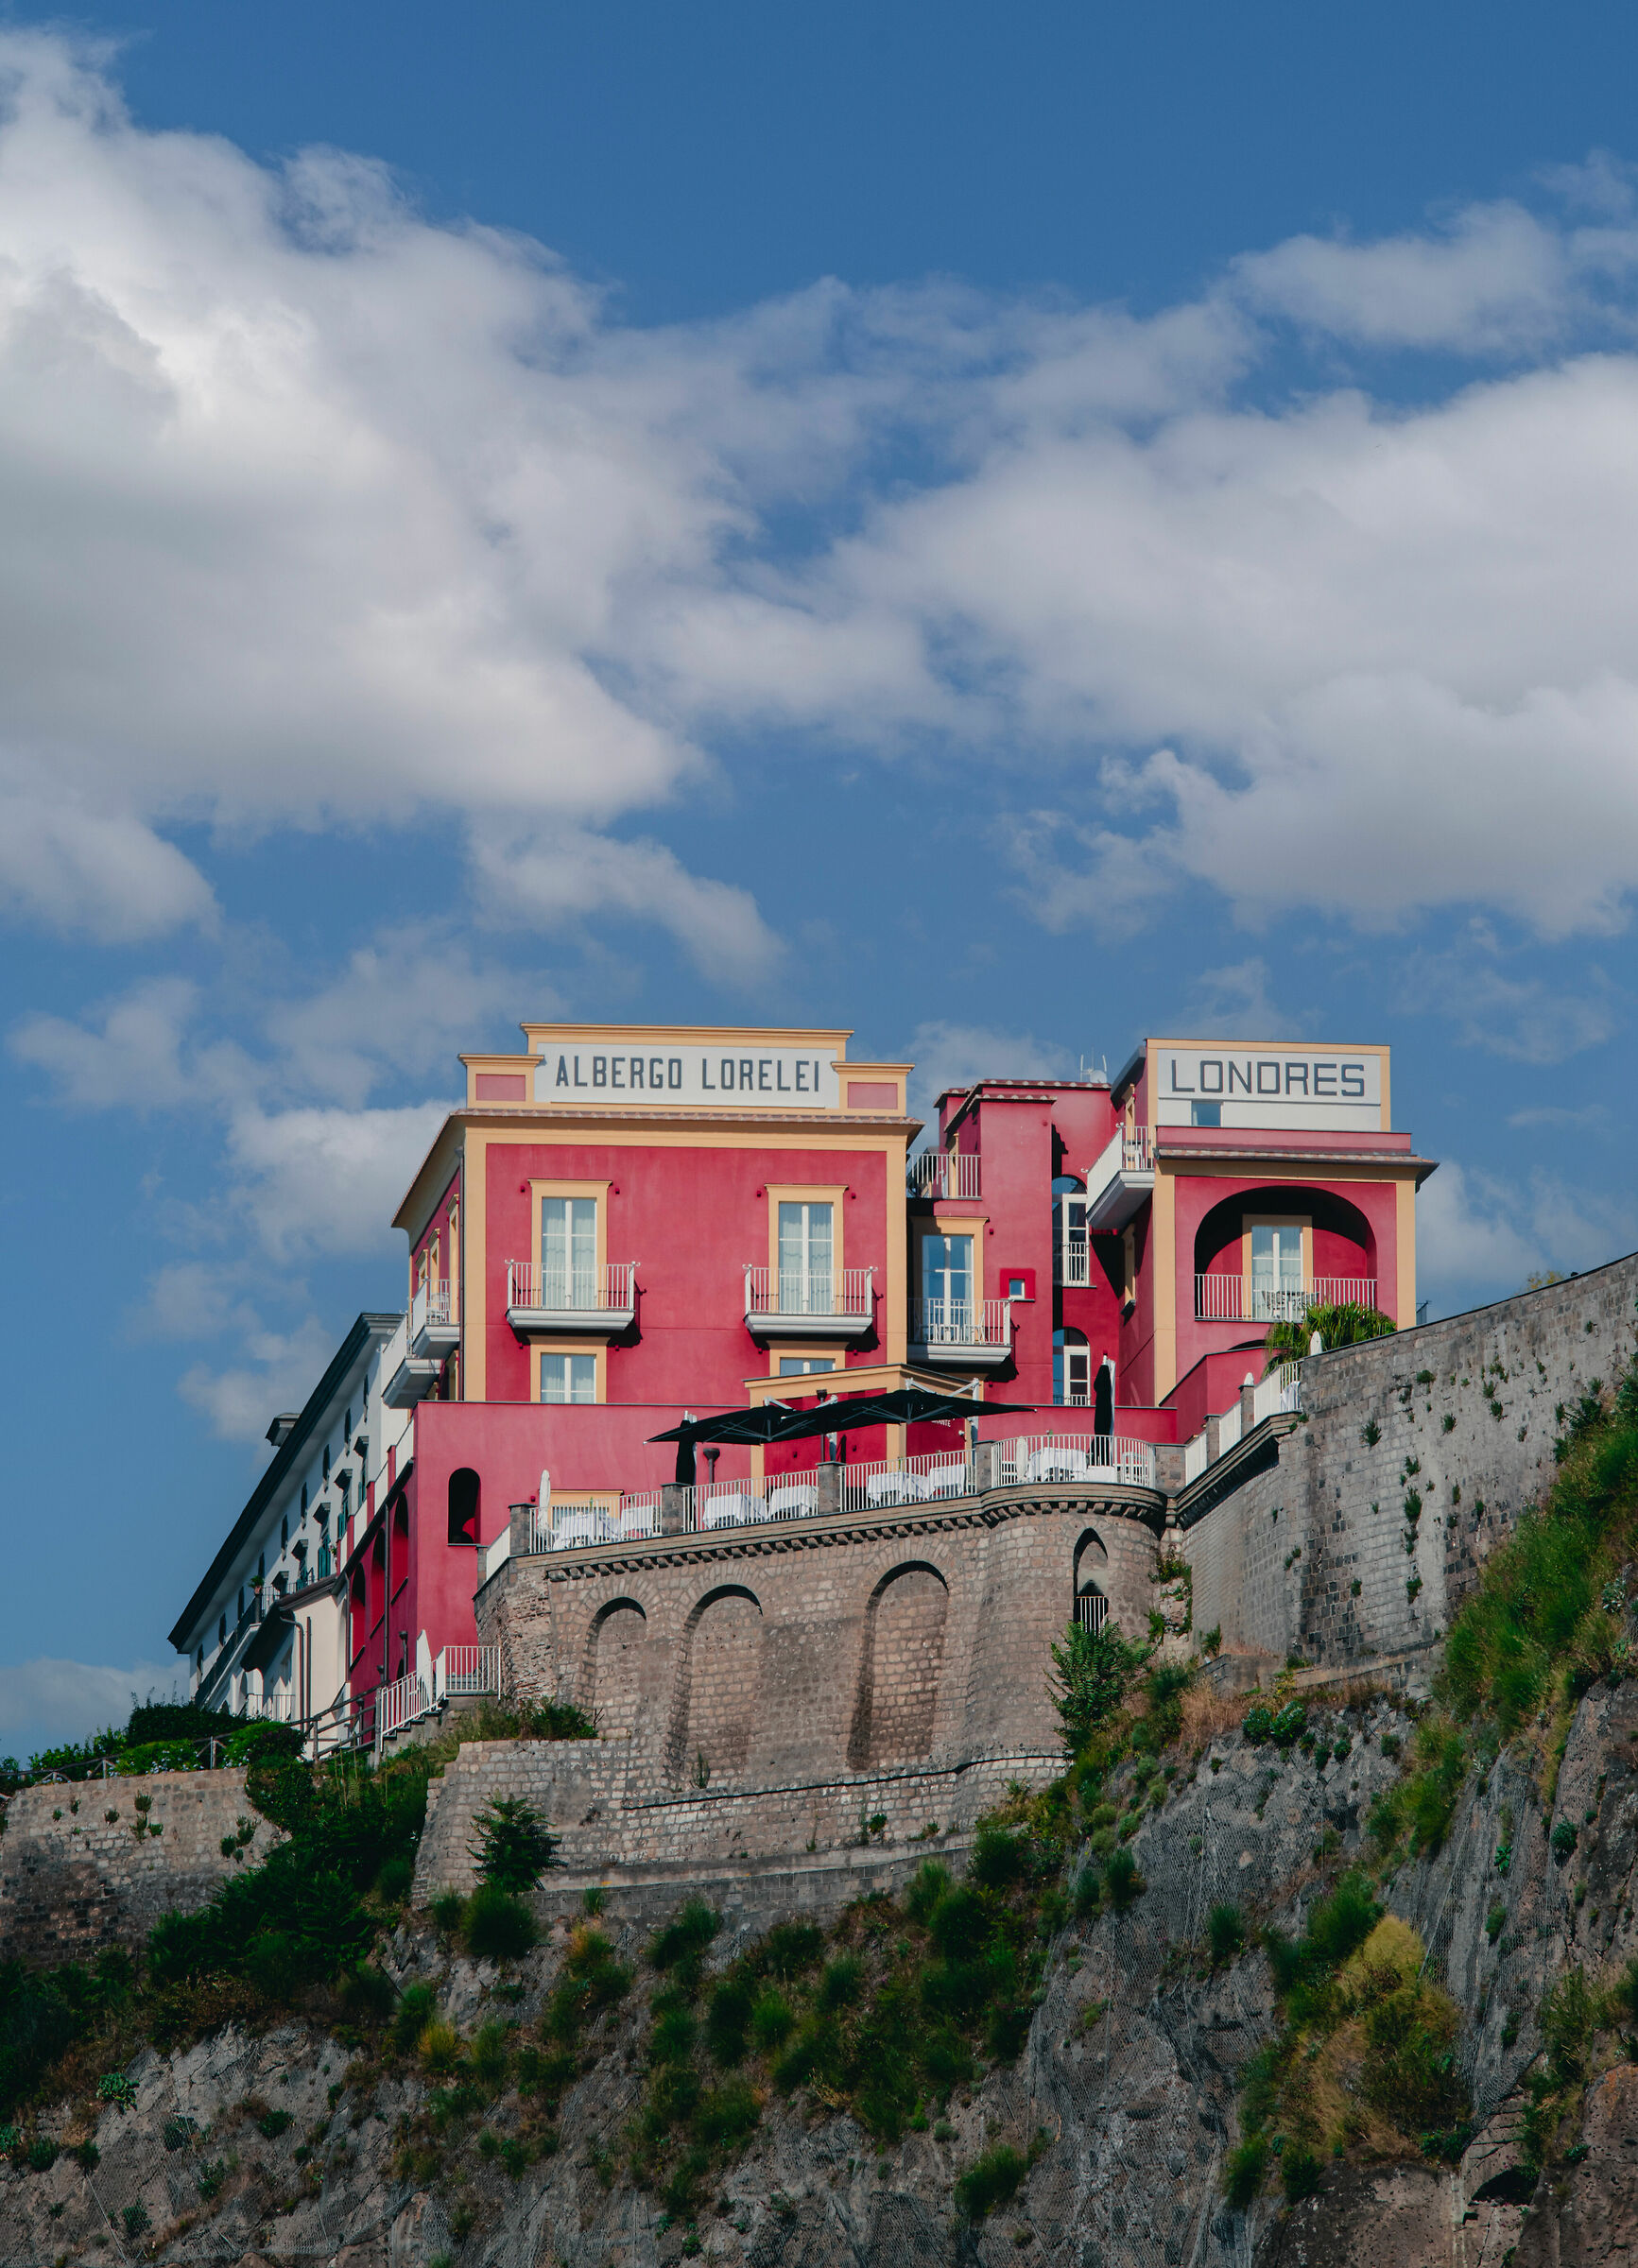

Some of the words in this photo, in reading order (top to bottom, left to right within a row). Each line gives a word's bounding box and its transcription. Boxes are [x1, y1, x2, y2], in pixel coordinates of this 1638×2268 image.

[555, 1055, 682, 1090] ALBERGO
[701, 1057, 819, 1092] LORELEI
[1171, 1059, 1365, 1097] LONDRES
